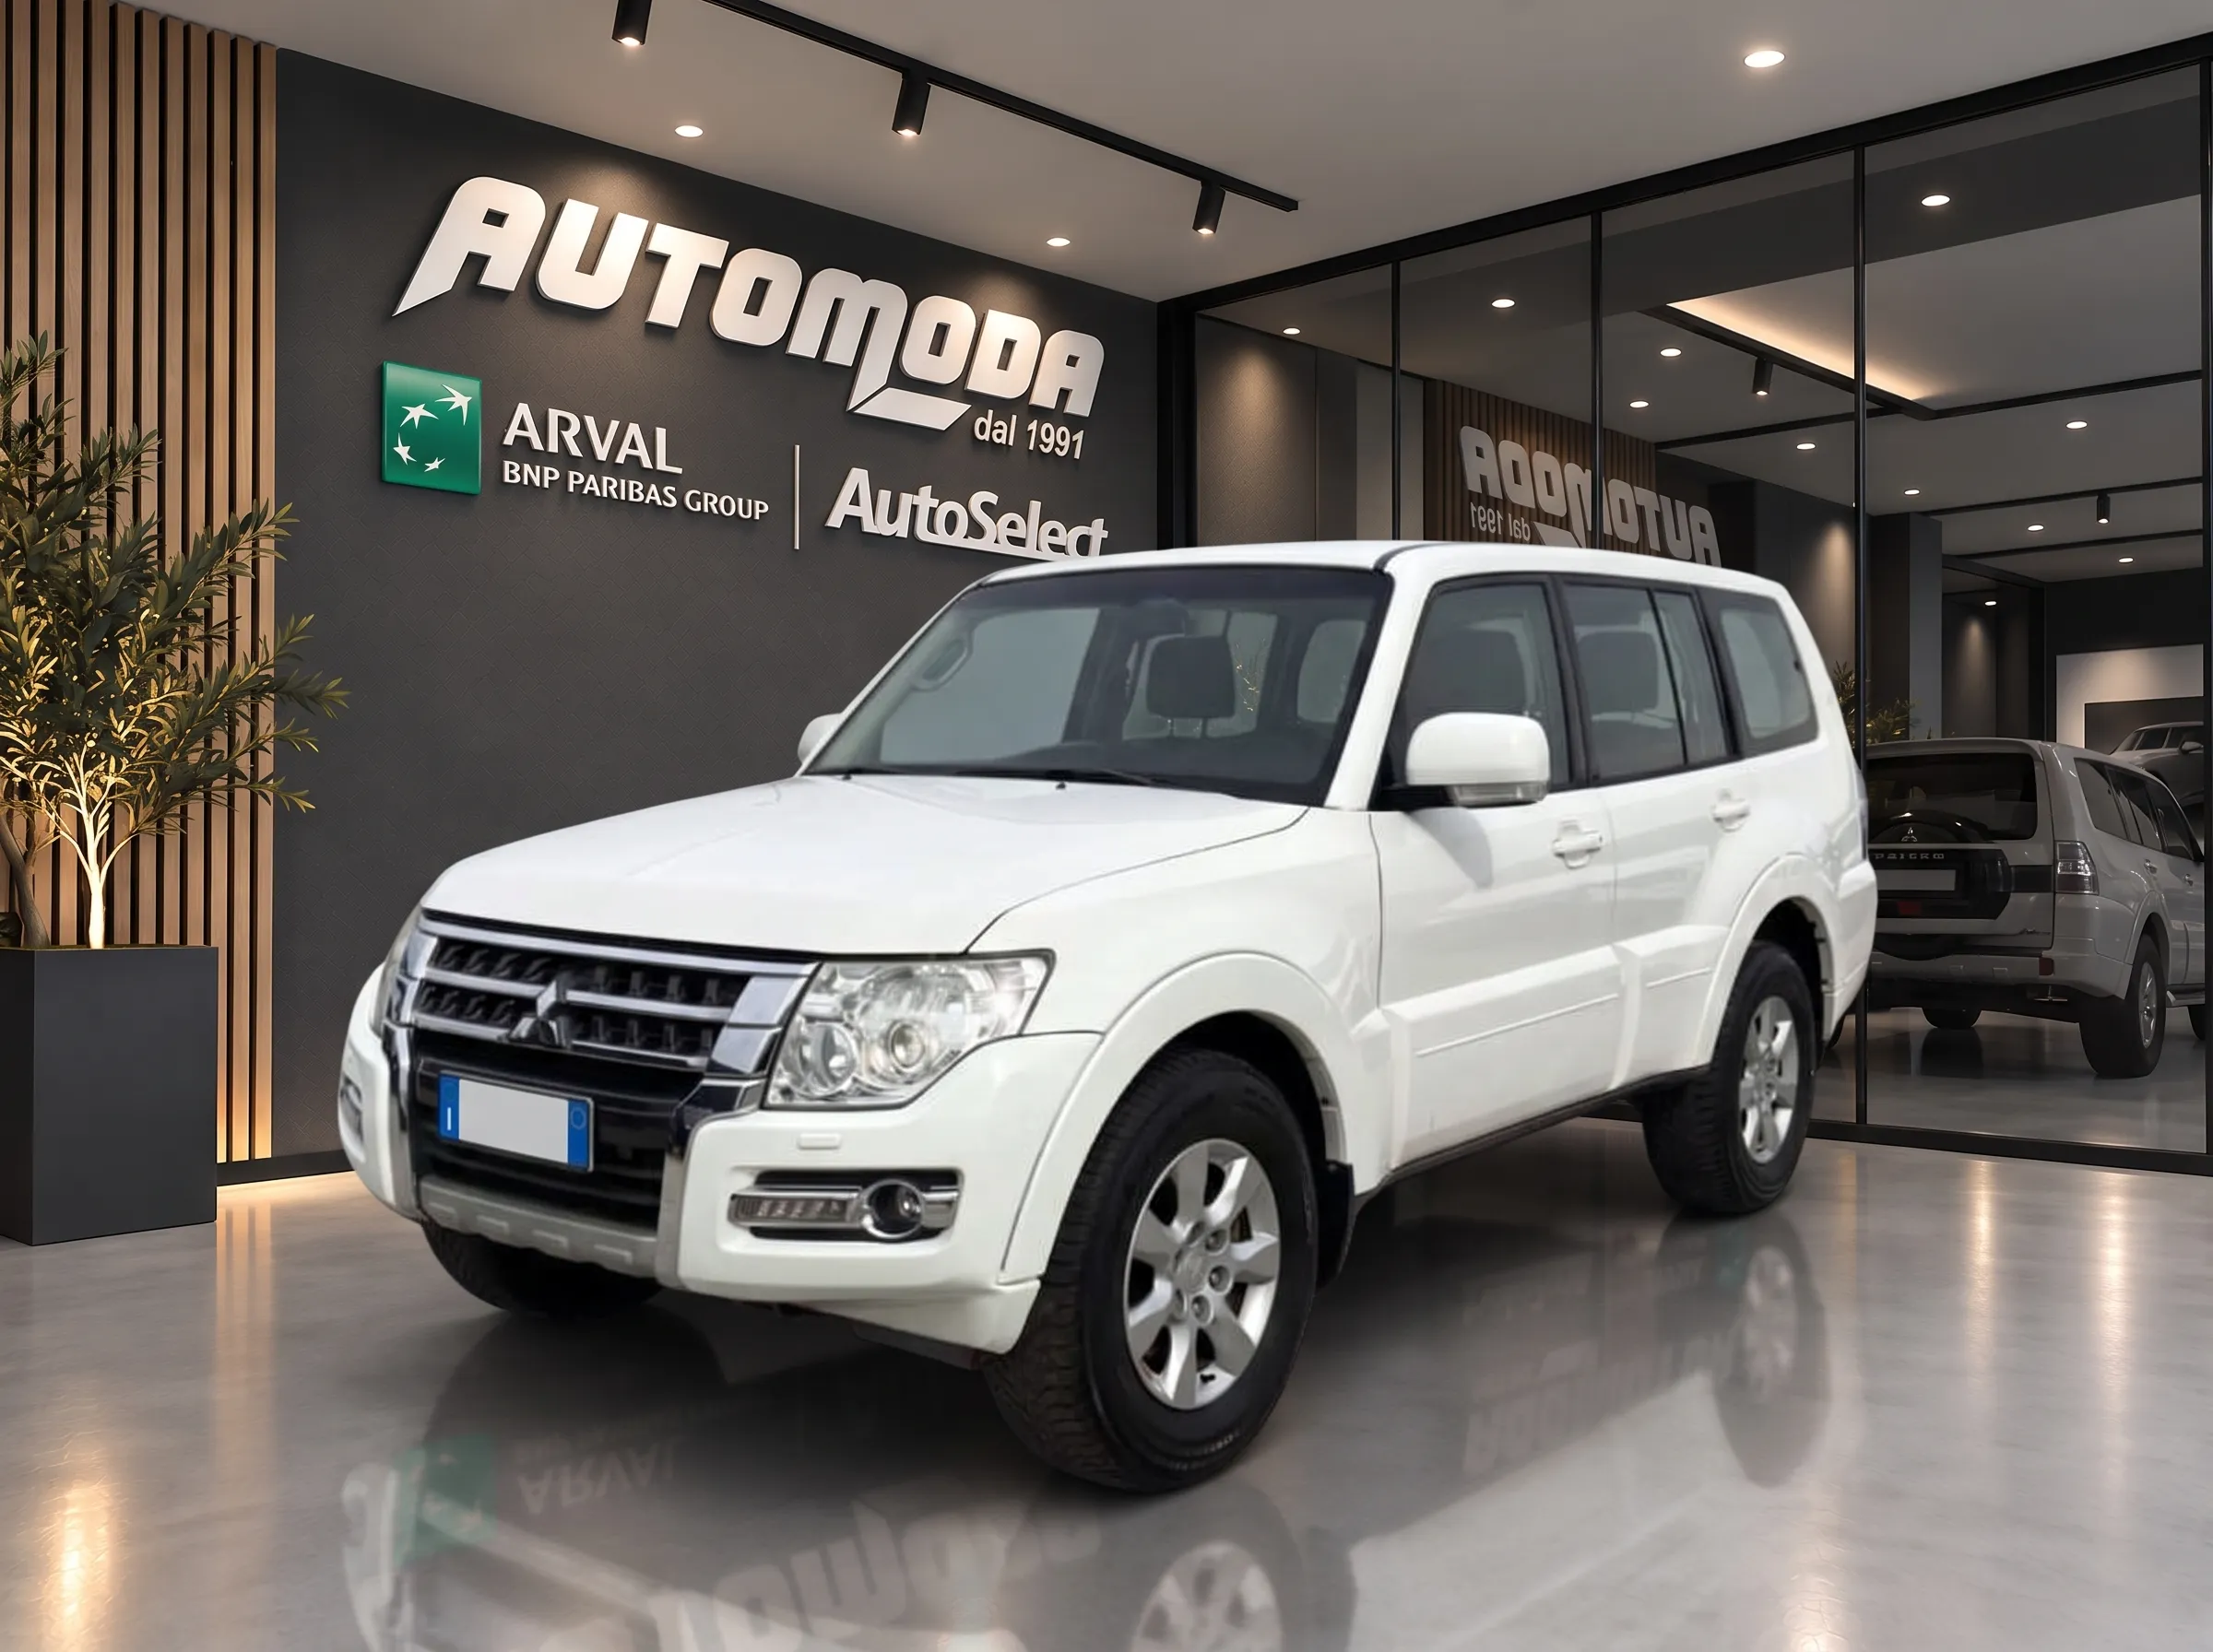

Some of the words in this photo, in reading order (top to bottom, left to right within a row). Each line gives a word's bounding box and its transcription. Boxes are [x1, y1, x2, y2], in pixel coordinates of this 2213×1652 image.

[392, 176, 1105, 431] AUTOMODA
[502, 402, 683, 475] ARVAL
[974, 408, 1017, 446] dal
[1026, 419, 1084, 460] 1991
[503, 460, 560, 489] BNP
[567, 470, 678, 508] PARIBAS
[683, 490, 769, 520] GROUP
[824, 466, 1109, 561] AutoSelect
